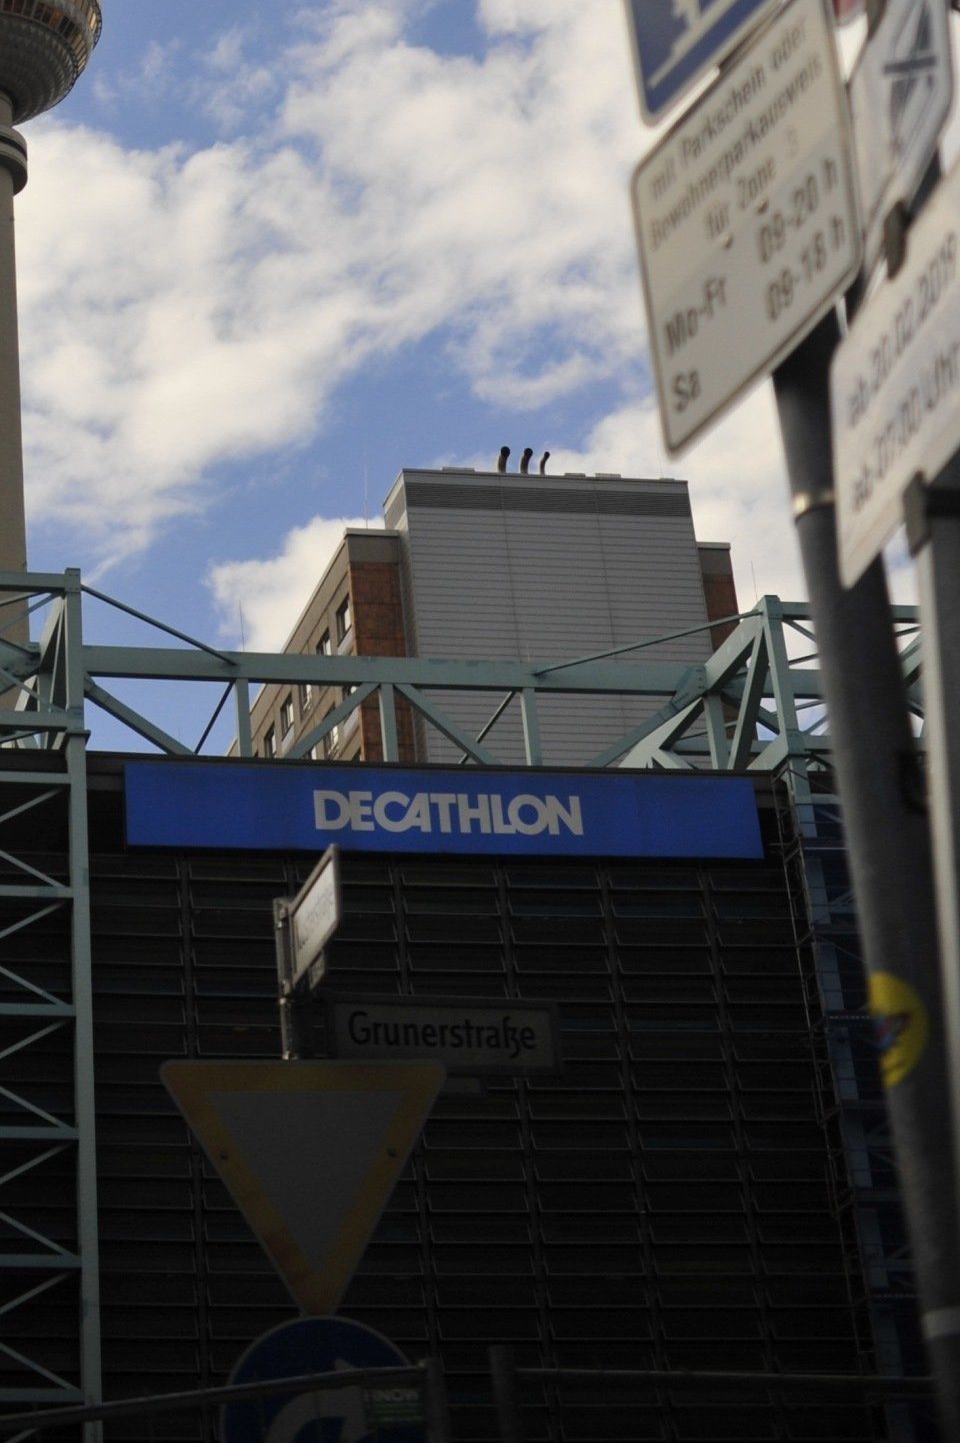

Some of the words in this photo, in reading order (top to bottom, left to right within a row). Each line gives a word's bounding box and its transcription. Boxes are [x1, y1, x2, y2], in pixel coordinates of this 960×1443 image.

[651, 54, 822, 250] Bewohnerparkausweis
[681, 63, 766, 165] Parkschein
[772, 15, 807, 72] oder
[664, 276, 727, 356] Mo-Fr
[757, 172, 819, 264] 09-20
[823, 158, 838, 194] h
[738, 156, 775, 210] Zone
[673, 368, 701, 414] Sa
[830, 214, 845, 251] h
[313, 789, 584, 836] DECATHLON
[348, 1011, 536, 1058] Grunerstraße
